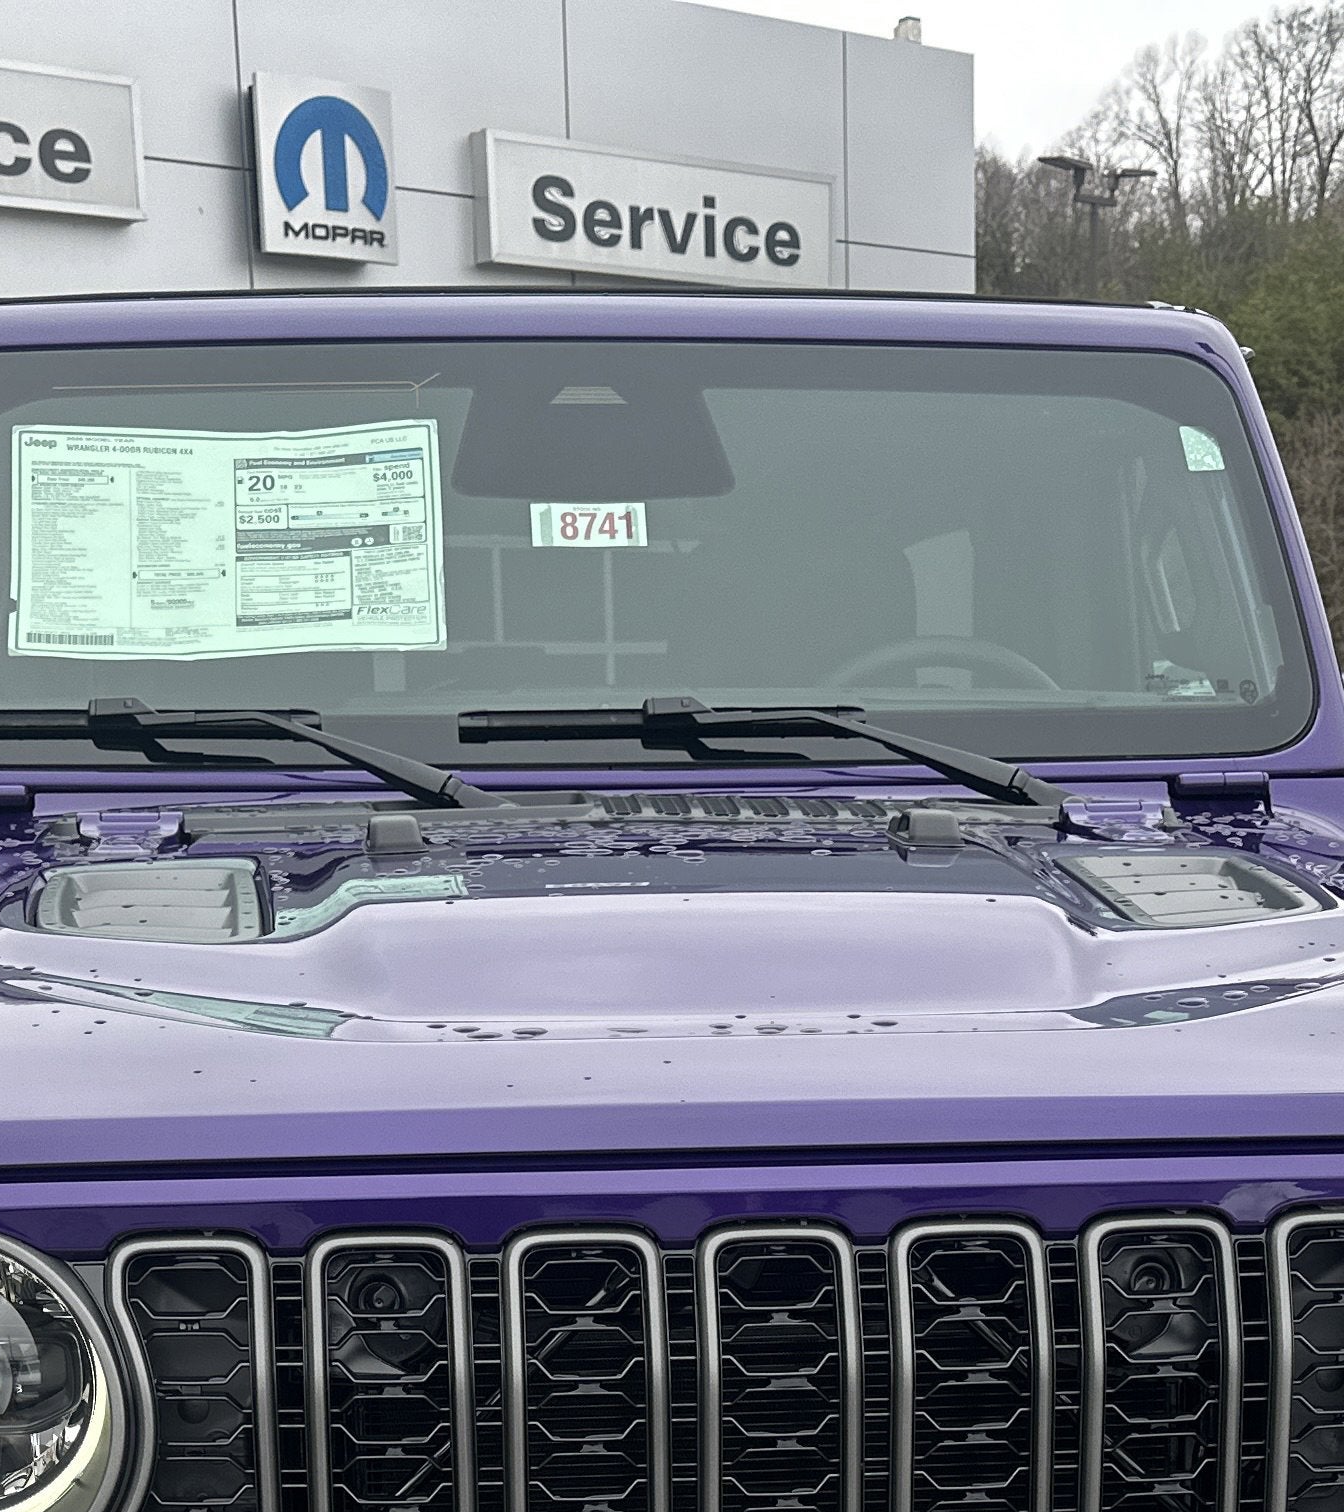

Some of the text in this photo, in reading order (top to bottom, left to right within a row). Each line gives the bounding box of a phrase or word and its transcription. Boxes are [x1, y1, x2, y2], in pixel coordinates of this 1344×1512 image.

[531, 174, 801, 267] Service
[283, 220, 386, 248] MOPAR
[24, 436, 58, 449] Jeep
[66, 444, 110, 453] WRANGLER
[143, 446, 178, 455] RUBICON
[247, 474, 276, 492] 20
[372, 470, 414, 483] $4,000
[238, 514, 281, 525] $2,500
[560, 511, 633, 541] 8741
[356, 604, 427, 615] FlexCare
